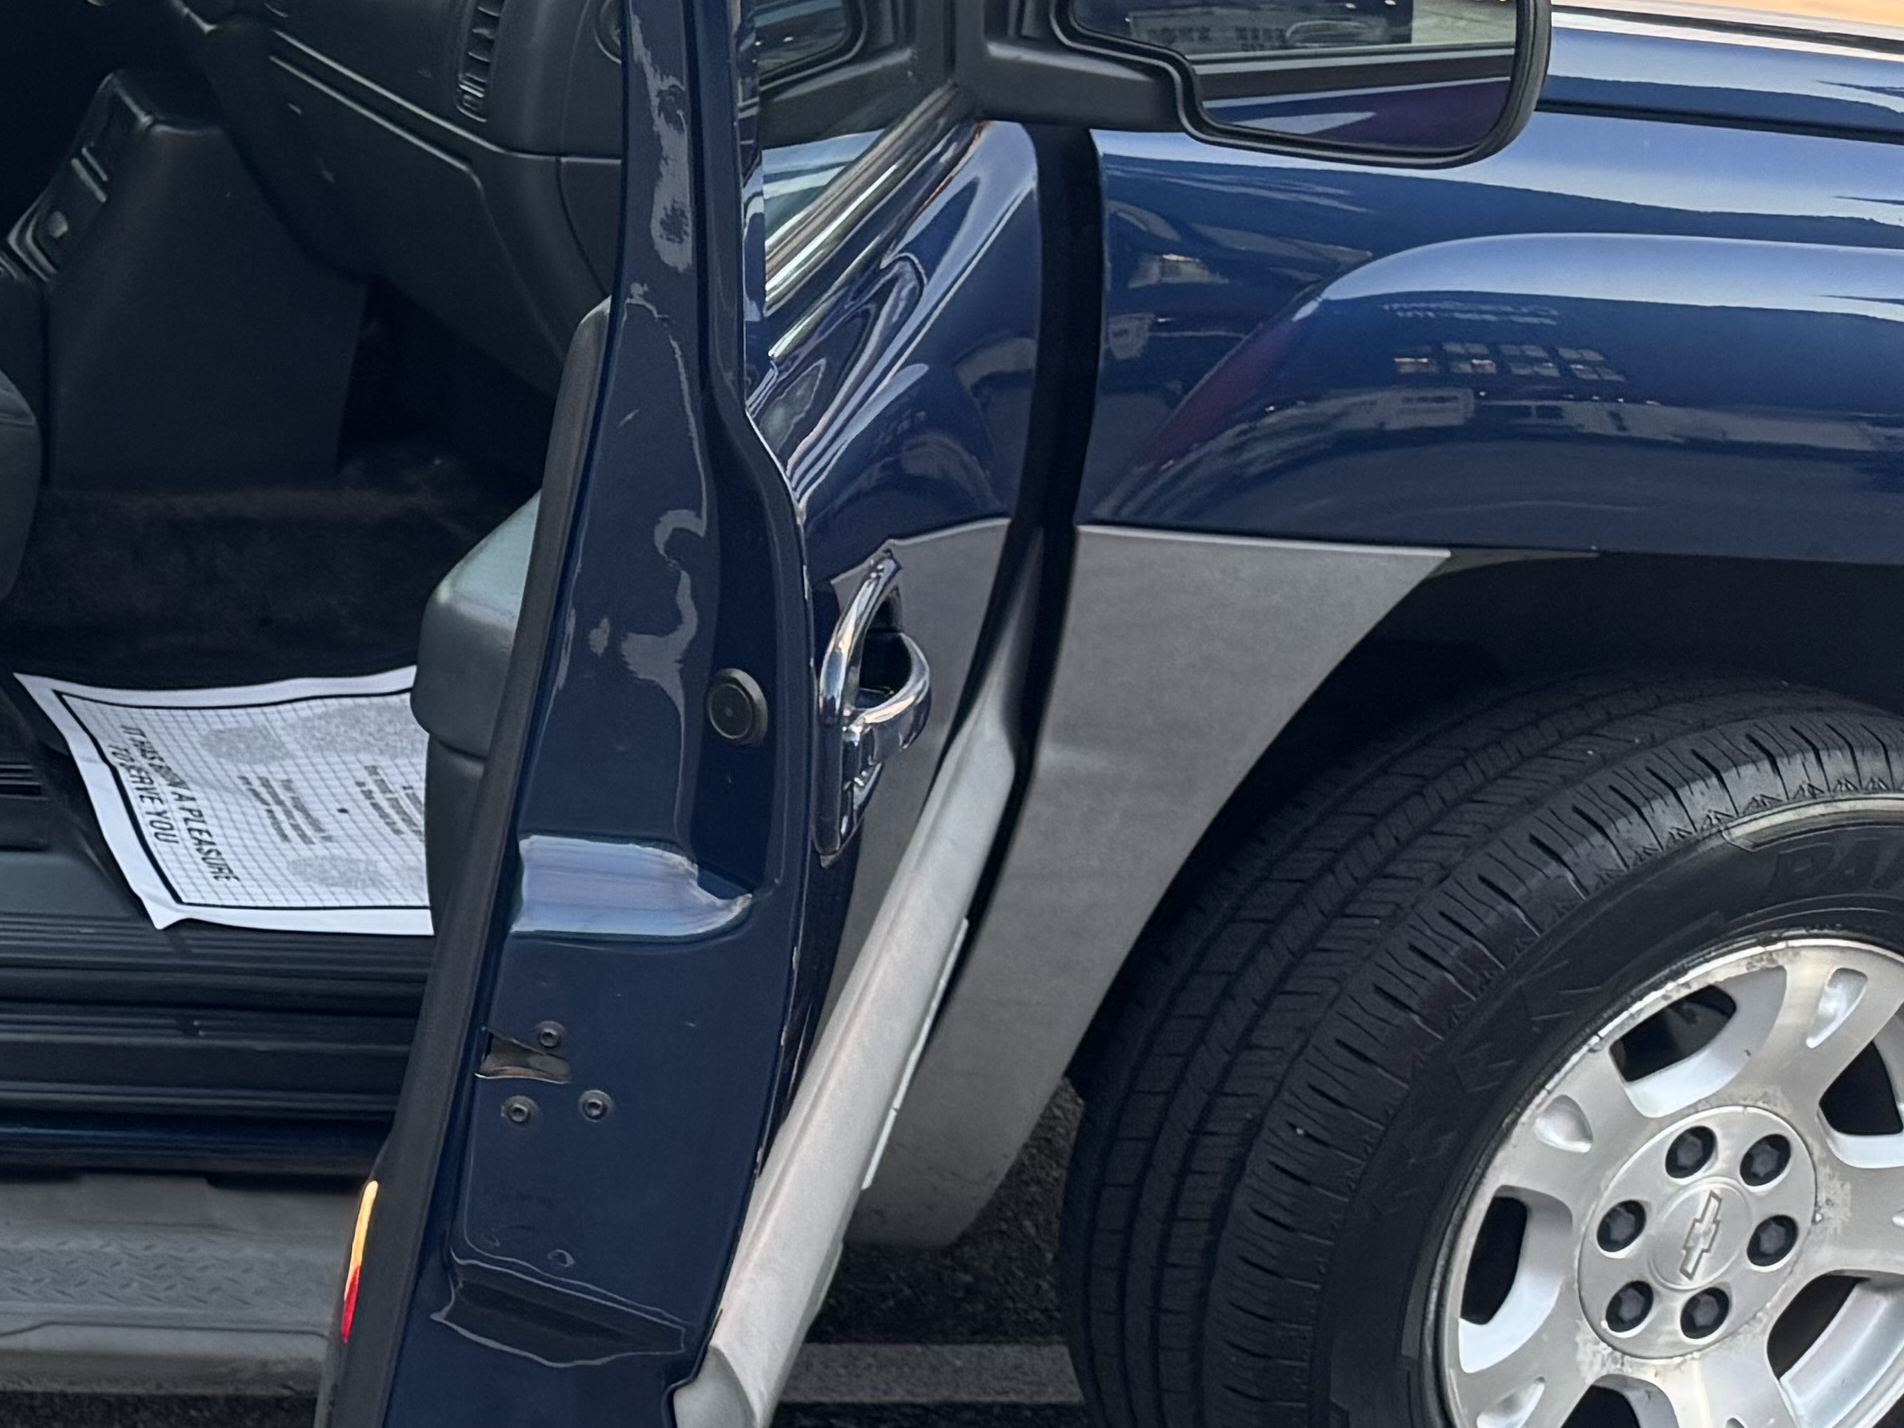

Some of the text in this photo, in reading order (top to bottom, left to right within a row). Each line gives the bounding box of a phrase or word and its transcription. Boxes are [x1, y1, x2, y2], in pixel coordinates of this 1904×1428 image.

[120, 724, 147, 738] IT
[170, 790, 197, 803] A
[145, 810, 180, 845] YOU
[177, 806, 242, 883] PLEASURE
